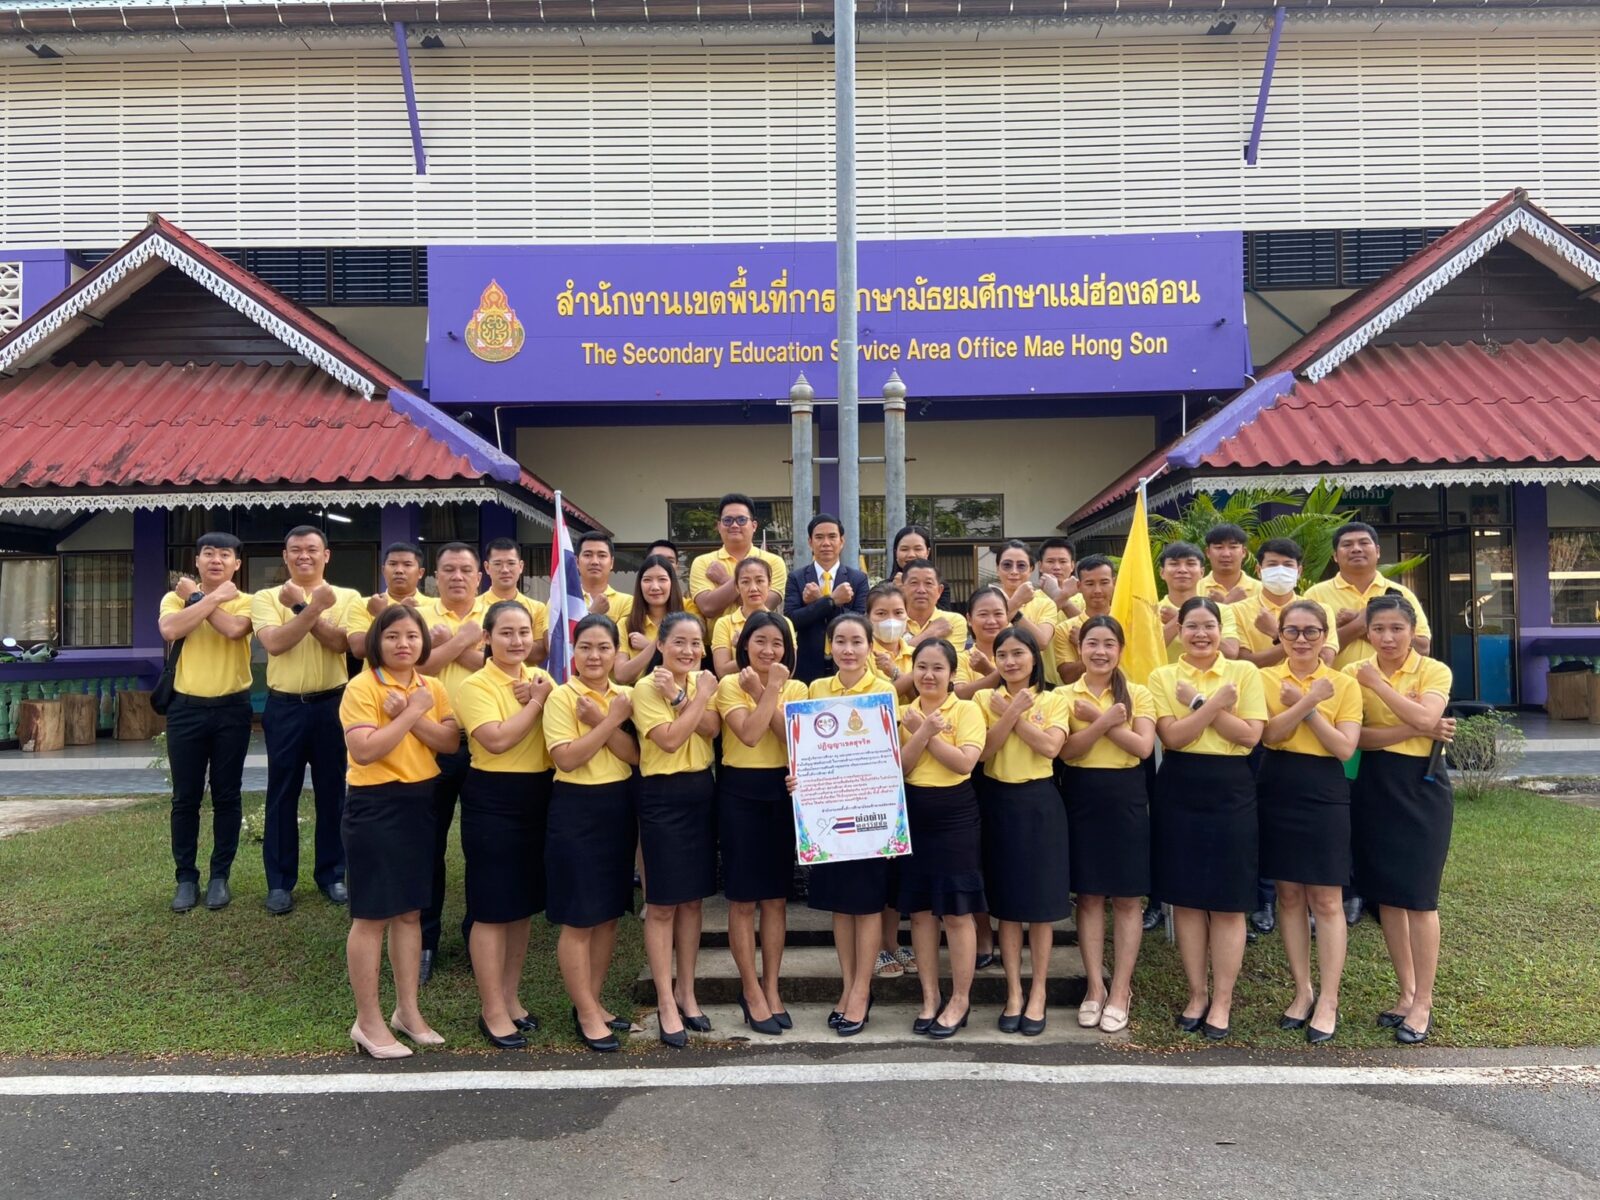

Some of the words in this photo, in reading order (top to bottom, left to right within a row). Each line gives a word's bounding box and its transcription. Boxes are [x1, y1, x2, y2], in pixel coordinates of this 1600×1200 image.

[556, 266, 1201, 316] สำนักงานเขตพื้นที่การกษามัธยมศึกษาแม่ฮ่องสอน
[582, 342, 617, 366] The
[622, 343, 723, 369] Secondary
[729, 341, 823, 365] Education
[829, 339, 901, 363] Srvice
[907, 338, 951, 361] Area
[957, 336, 1018, 360] Office
[1024, 335, 1065, 358] Mae
[1071, 334, 1123, 361] Hong
[1130, 331, 1169, 356] Son
